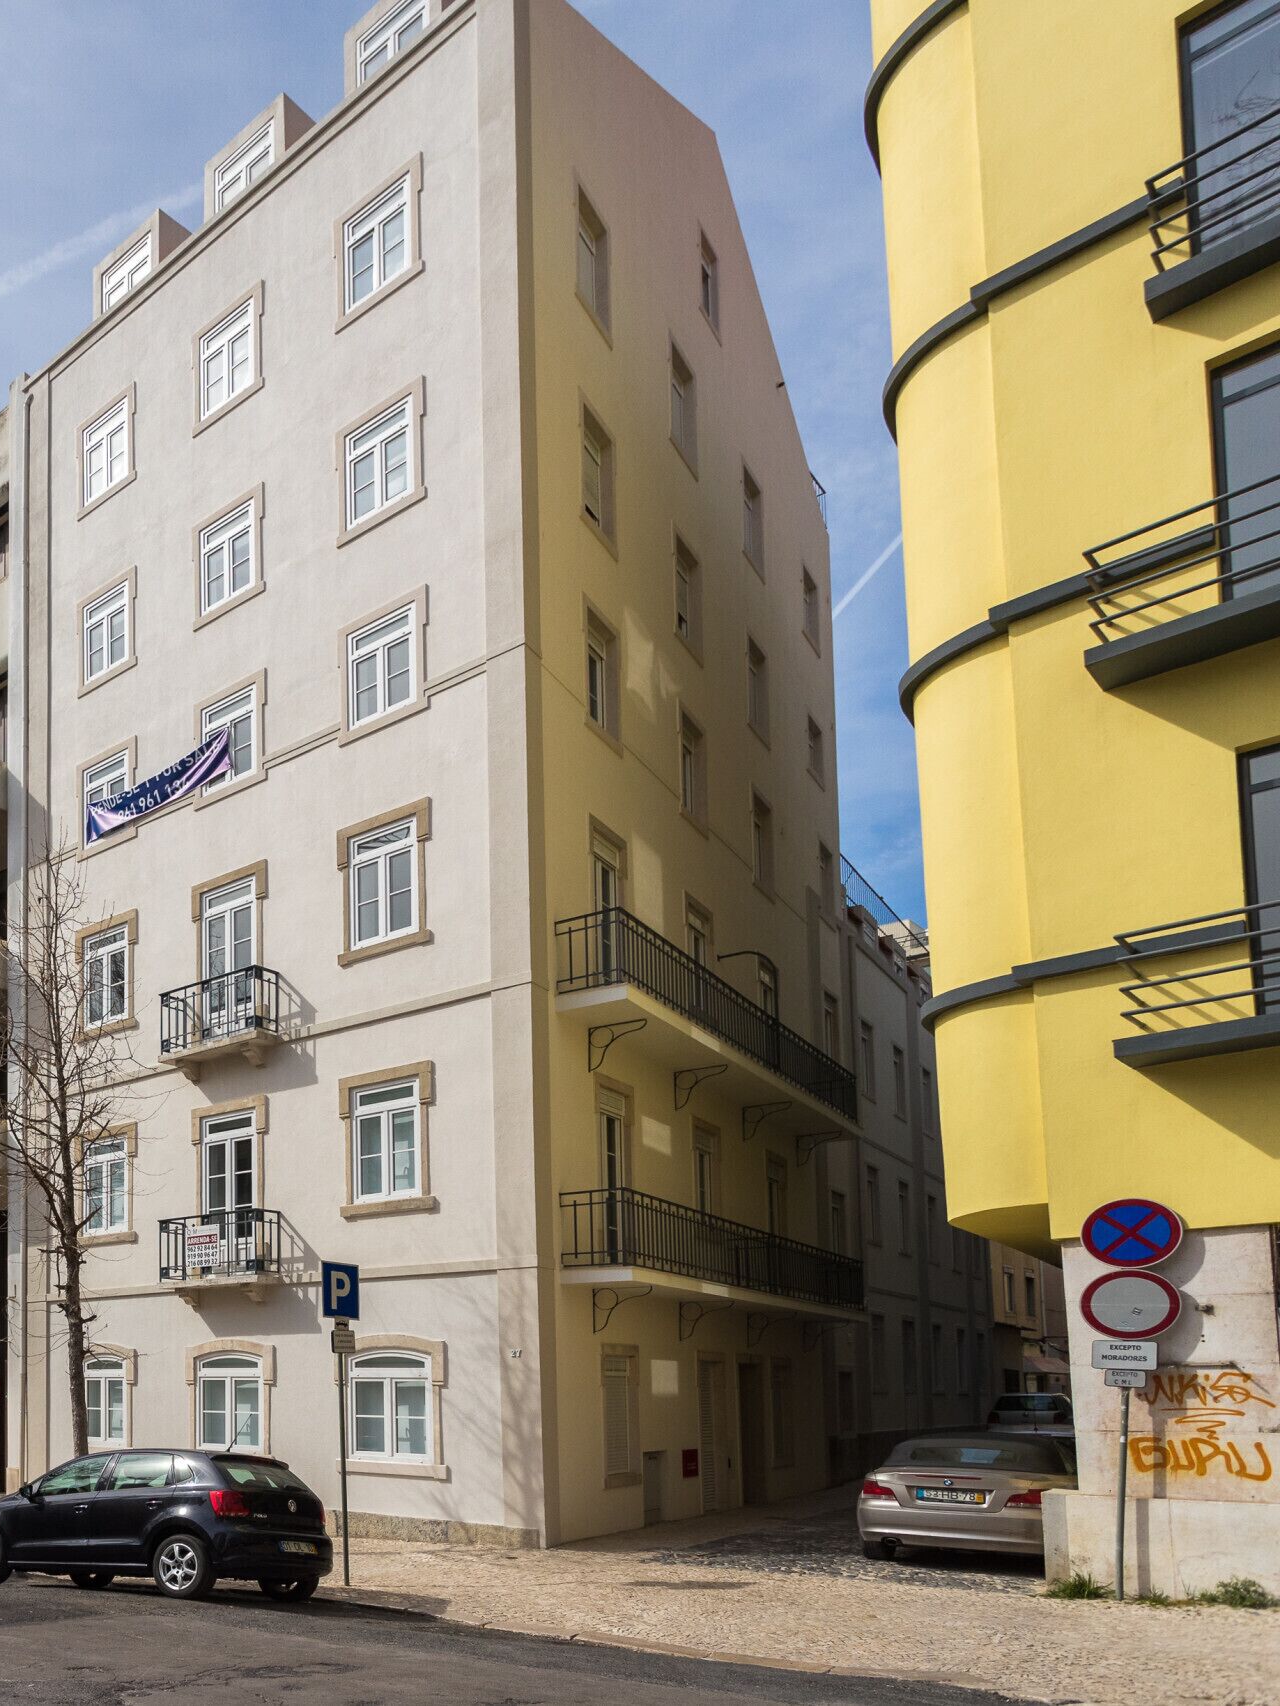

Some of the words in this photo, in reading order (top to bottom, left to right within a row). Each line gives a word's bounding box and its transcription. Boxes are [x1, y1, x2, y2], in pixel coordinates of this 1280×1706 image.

[138, 789, 162, 811] 961
[187, 1234, 217, 1245] ARRENDA-SE
[330, 1270, 351, 1310] P
[1101, 1354, 1148, 1362] MORADORES
